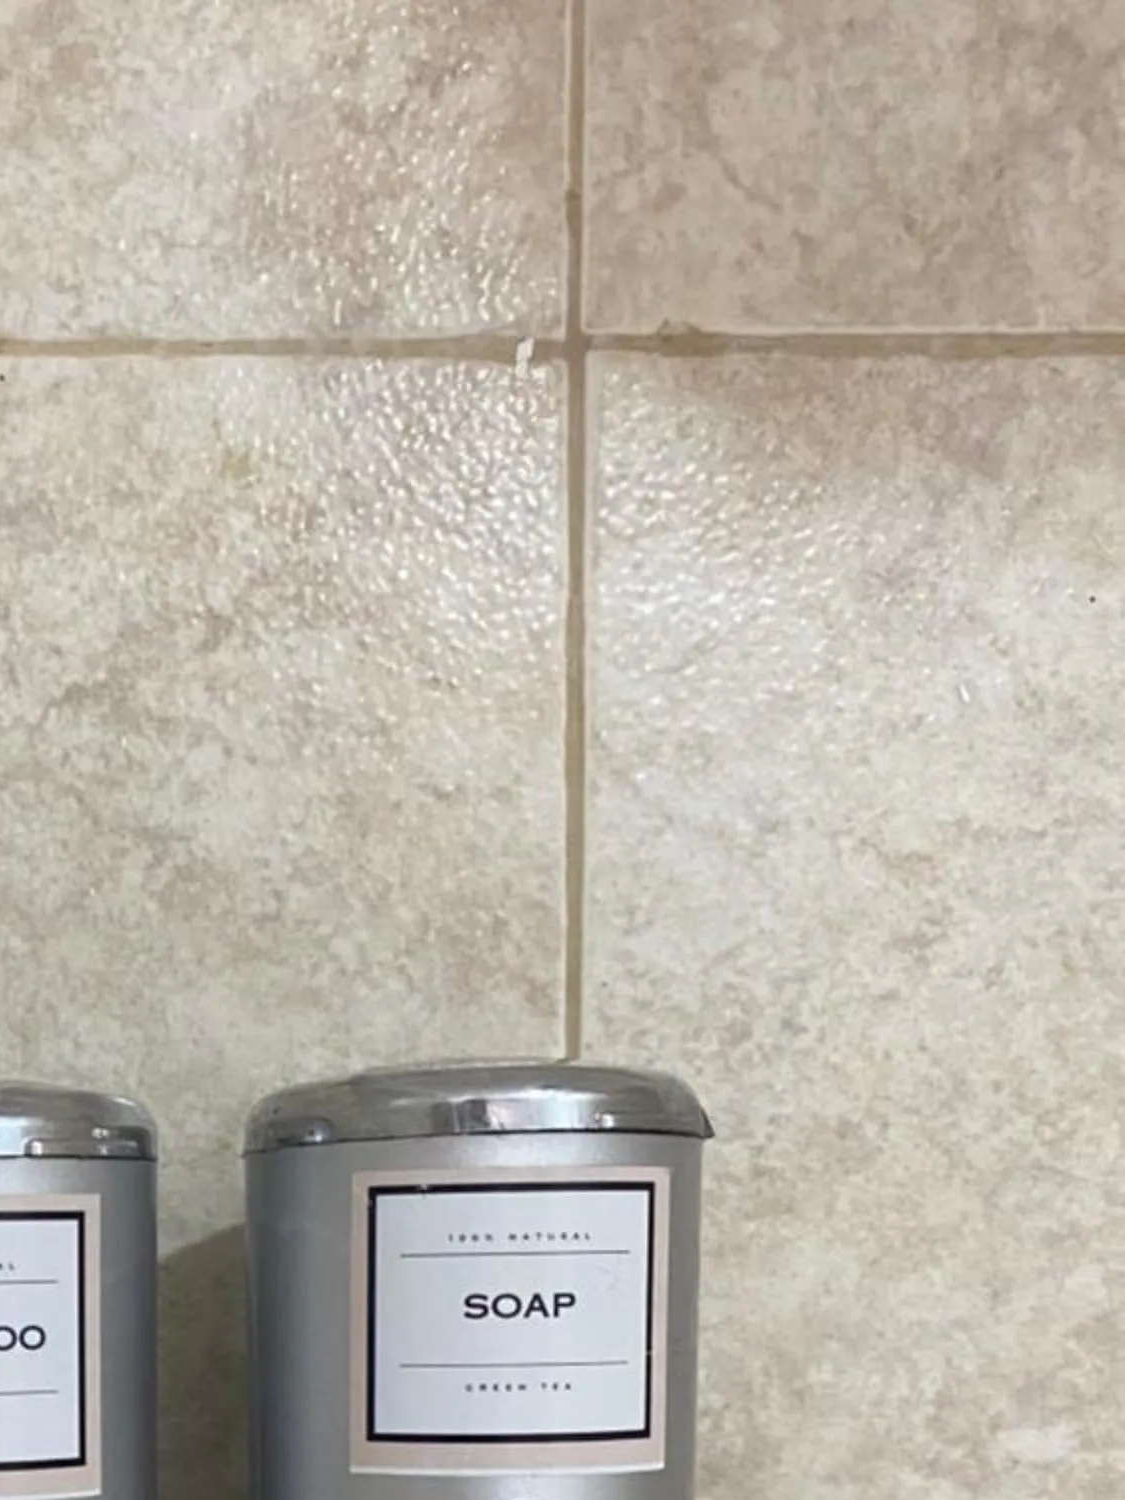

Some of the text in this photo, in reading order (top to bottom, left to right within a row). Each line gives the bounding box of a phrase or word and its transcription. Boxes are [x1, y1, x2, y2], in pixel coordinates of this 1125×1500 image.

[506, 1230, 593, 1243] NATURAL
[463, 1291, 577, 1321] SOAP
[463, 1380, 574, 1394] GREEN TEA
